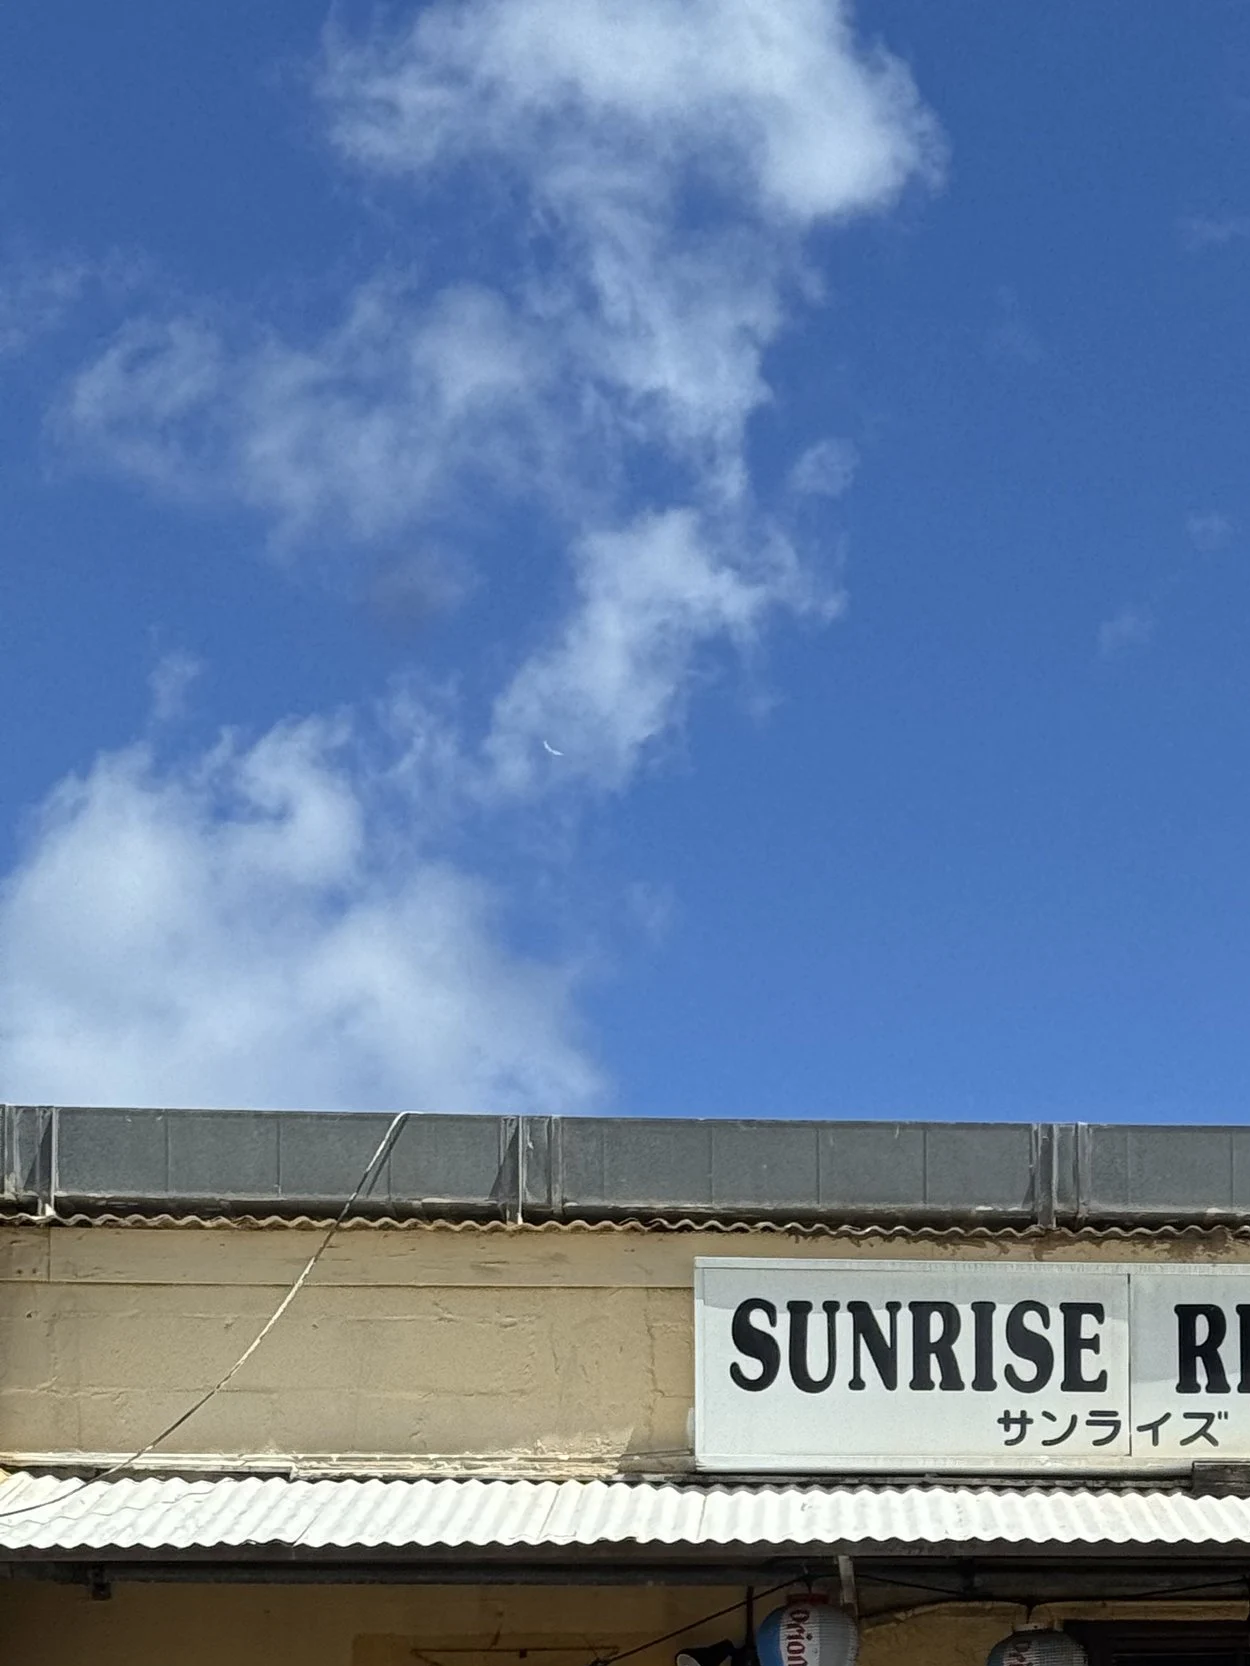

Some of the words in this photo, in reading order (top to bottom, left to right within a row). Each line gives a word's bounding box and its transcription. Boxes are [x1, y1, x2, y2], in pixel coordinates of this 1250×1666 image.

[728, 1297, 1108, 1394] SUNRISE
[996, 1409, 1230, 1449] サンライズ
